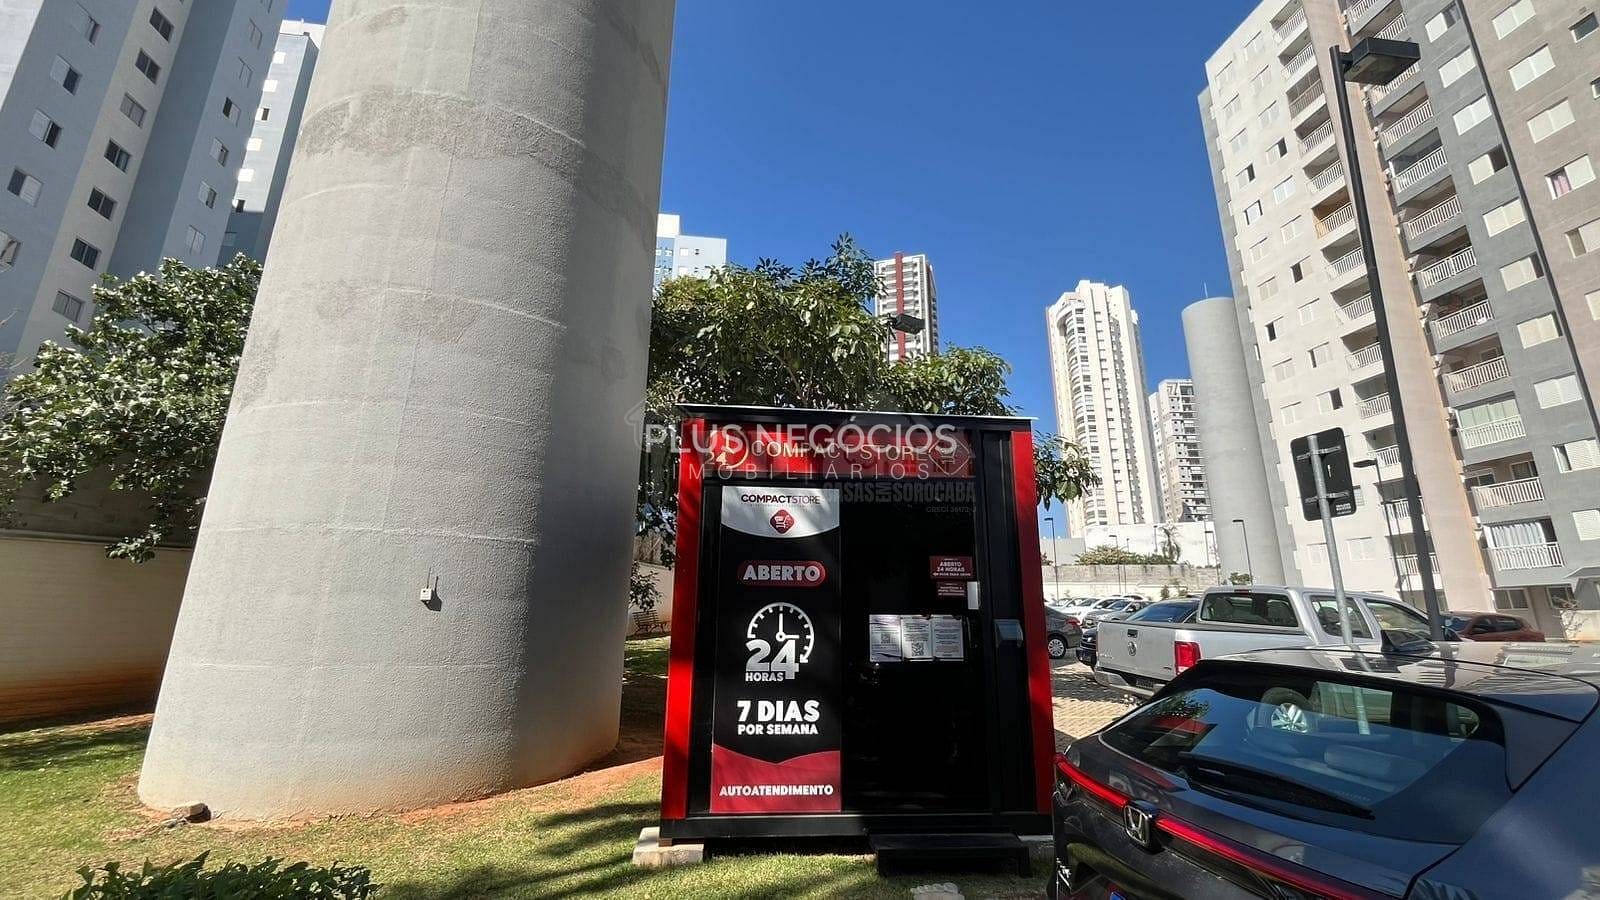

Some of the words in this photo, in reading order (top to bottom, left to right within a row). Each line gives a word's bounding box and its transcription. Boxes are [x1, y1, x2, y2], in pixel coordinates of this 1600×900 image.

[742, 564, 820, 582] ABERTO
[745, 638, 800, 680] 24
[745, 672, 784, 682] HORAS
[737, 700, 752, 722] 7
[757, 699, 820, 723] DIAS
[737, 724, 764, 735] POR
[766, 724, 819, 735] SEMANA
[719, 784, 834, 796] AUTOATENDIMENTO
